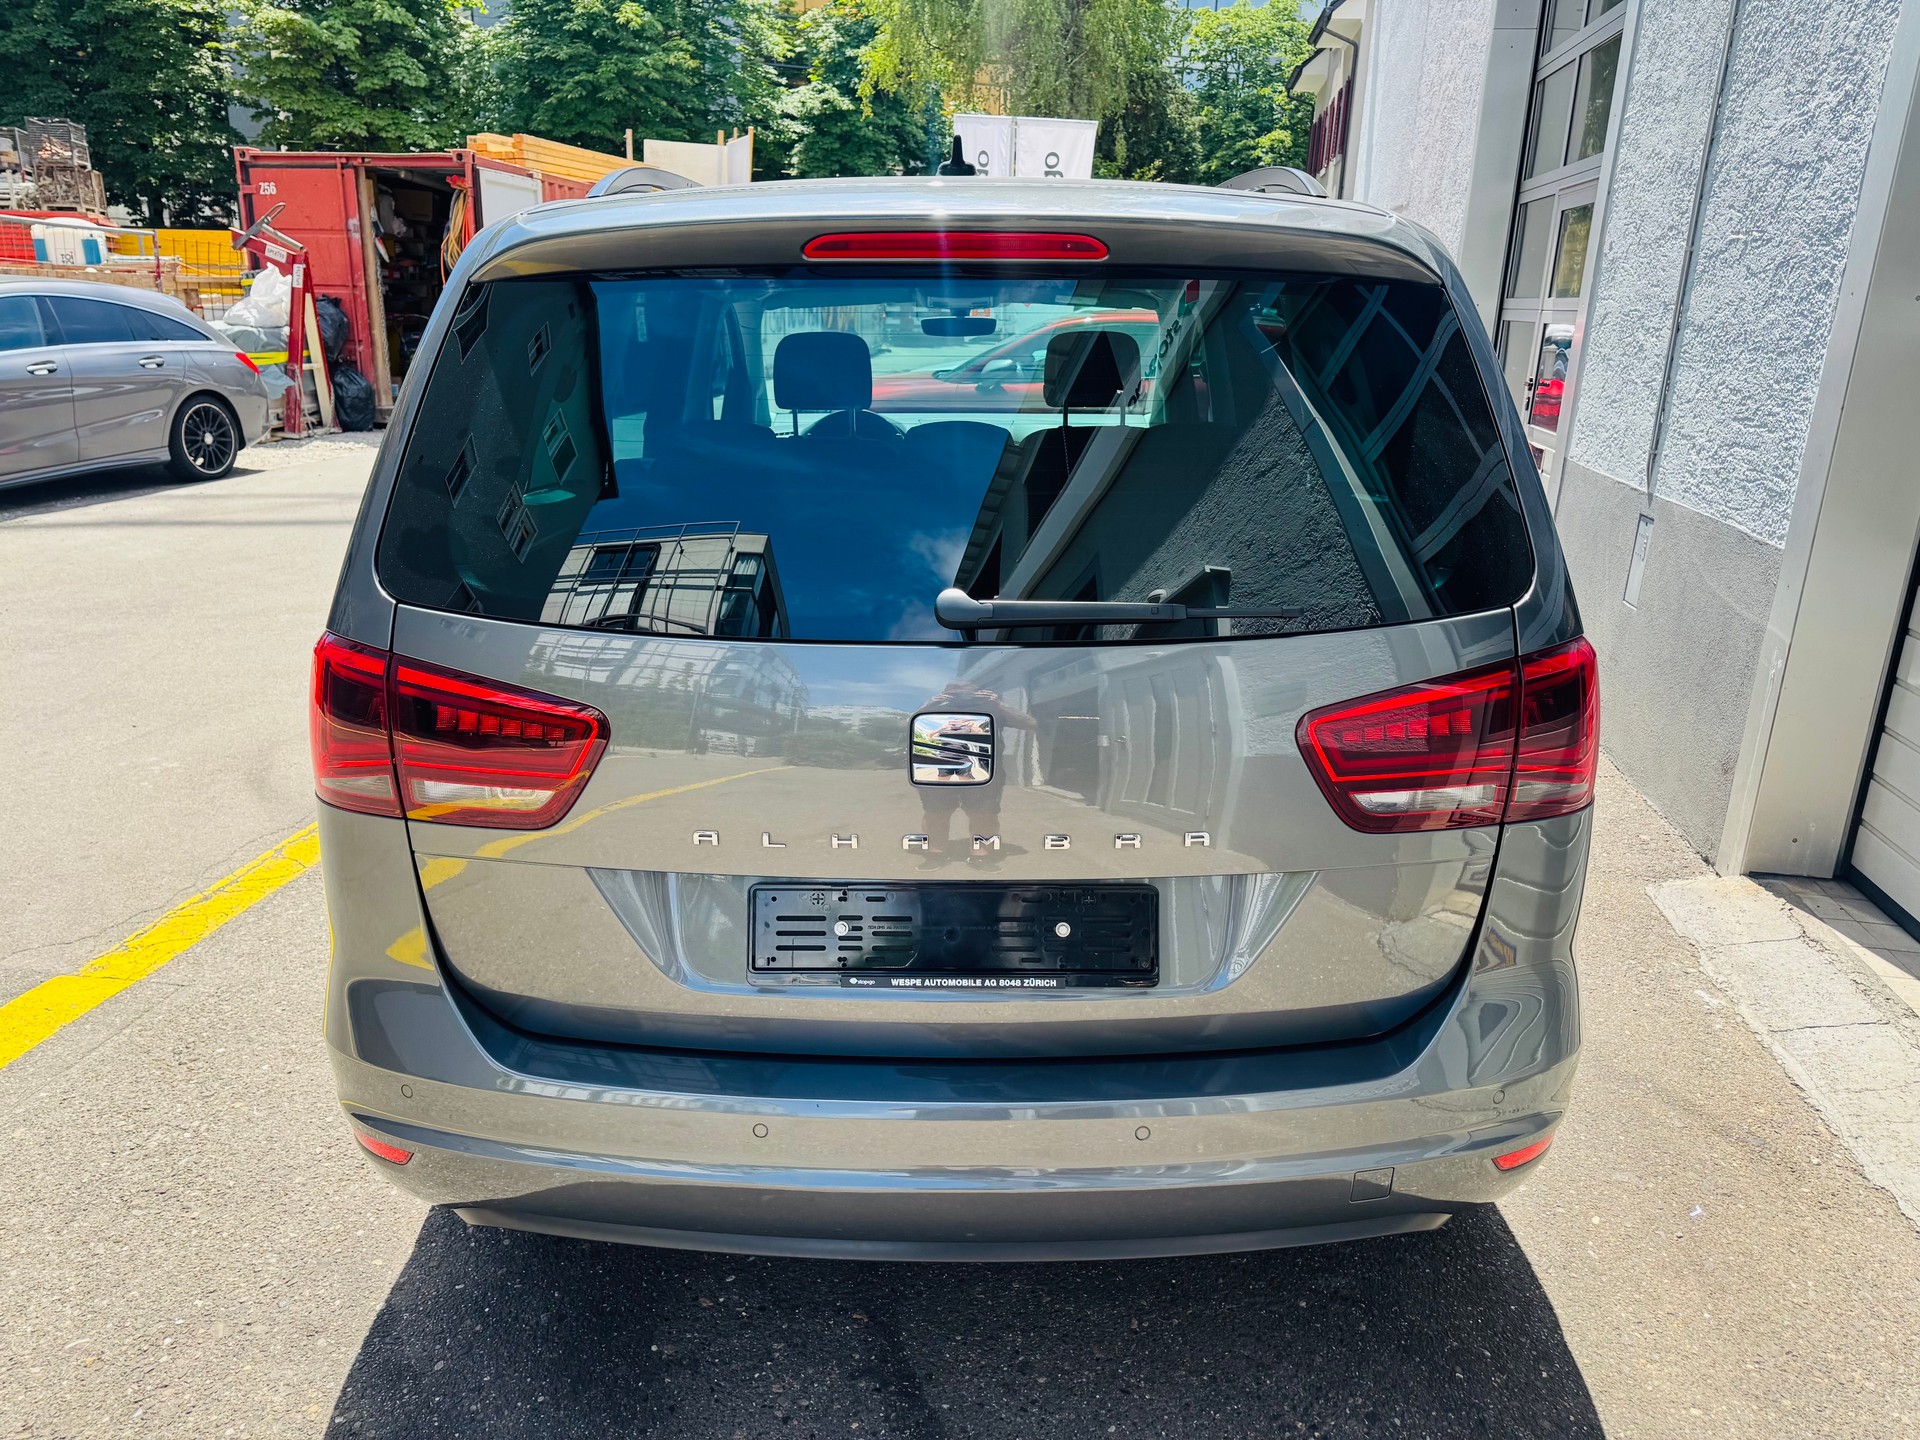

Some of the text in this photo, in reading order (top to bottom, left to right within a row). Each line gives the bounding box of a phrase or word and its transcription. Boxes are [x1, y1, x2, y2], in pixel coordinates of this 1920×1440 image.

[692, 829, 1211, 850] ALHAMBRA
[890, 978, 922, 986] WESPE
[923, 978, 982, 987] AUTOMOBILE
[984, 978, 997, 987] AG
[998, 978, 1022, 987] 8048
[1023, 977, 1057, 987] ZÜRICH
